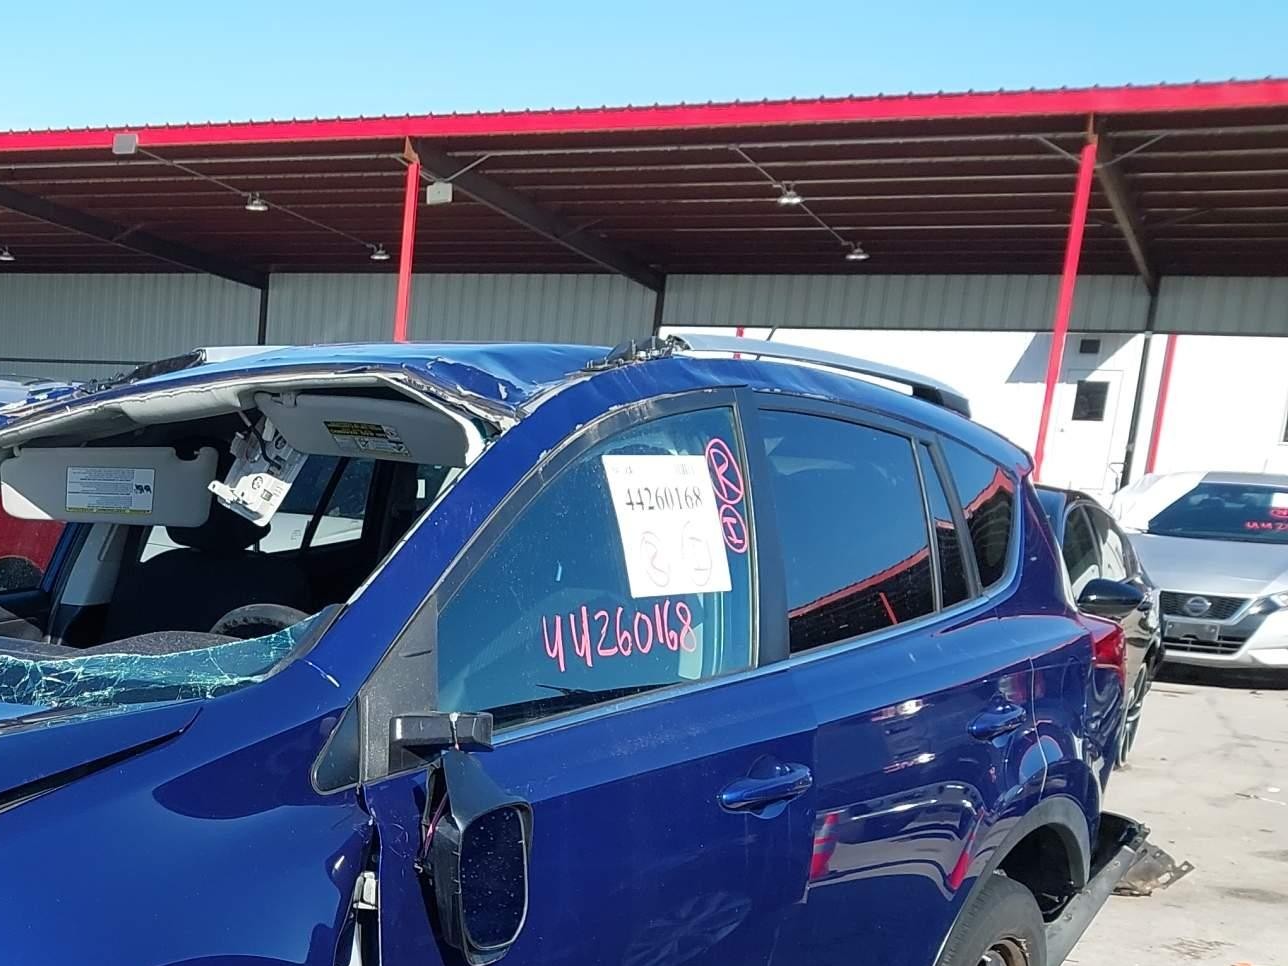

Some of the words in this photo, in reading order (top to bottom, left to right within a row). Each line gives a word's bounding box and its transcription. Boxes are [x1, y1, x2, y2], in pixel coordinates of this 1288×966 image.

[625, 487, 703, 511] 44260168
[708, 446, 744, 502] R
[542, 600, 698, 672] 44260168
